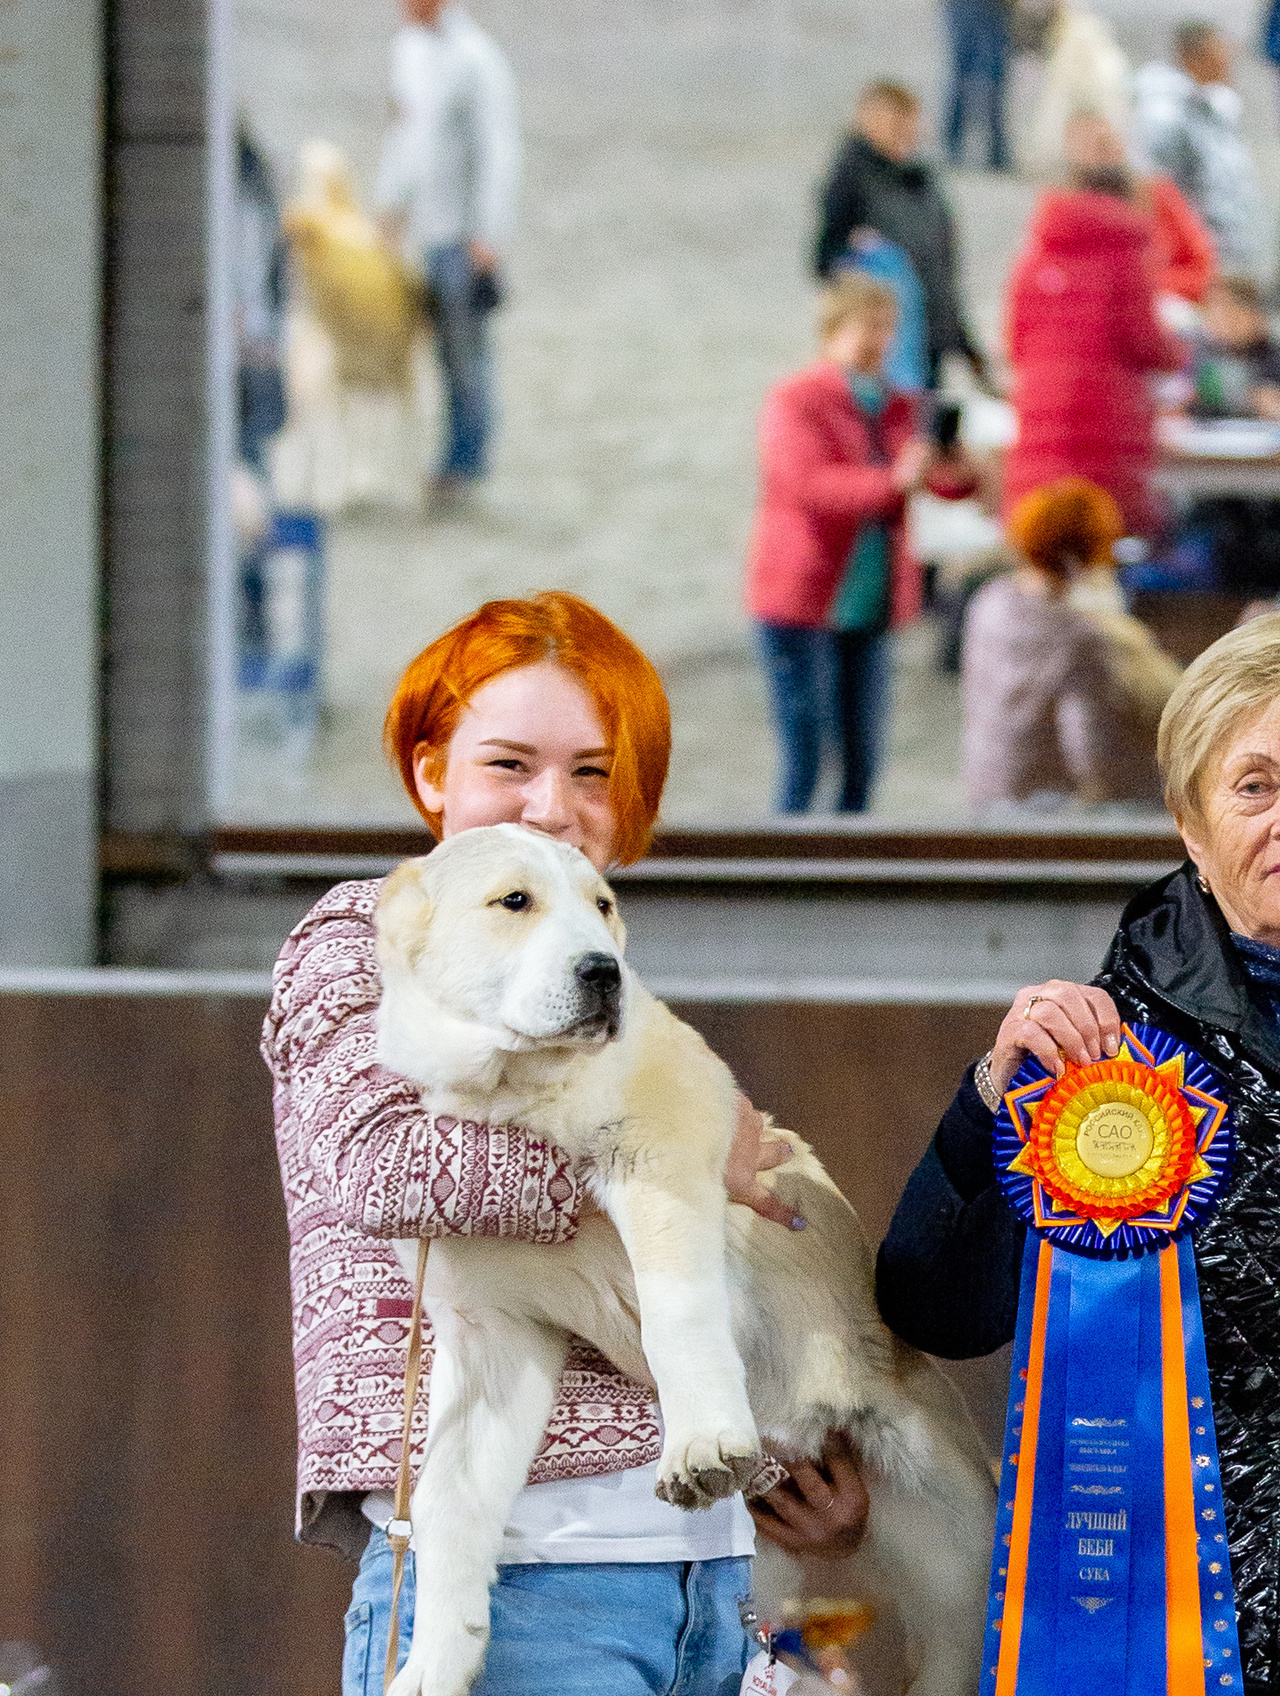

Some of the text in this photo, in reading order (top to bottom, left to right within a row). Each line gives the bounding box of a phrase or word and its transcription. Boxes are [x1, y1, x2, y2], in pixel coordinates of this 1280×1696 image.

[1098, 1124, 1133, 1139] САО
[1065, 1509, 1127, 1531] ЛУЧШИЙ
[1078, 1538, 1113, 1556] БЕБИ
[1079, 1567, 1110, 1581] СУКА
